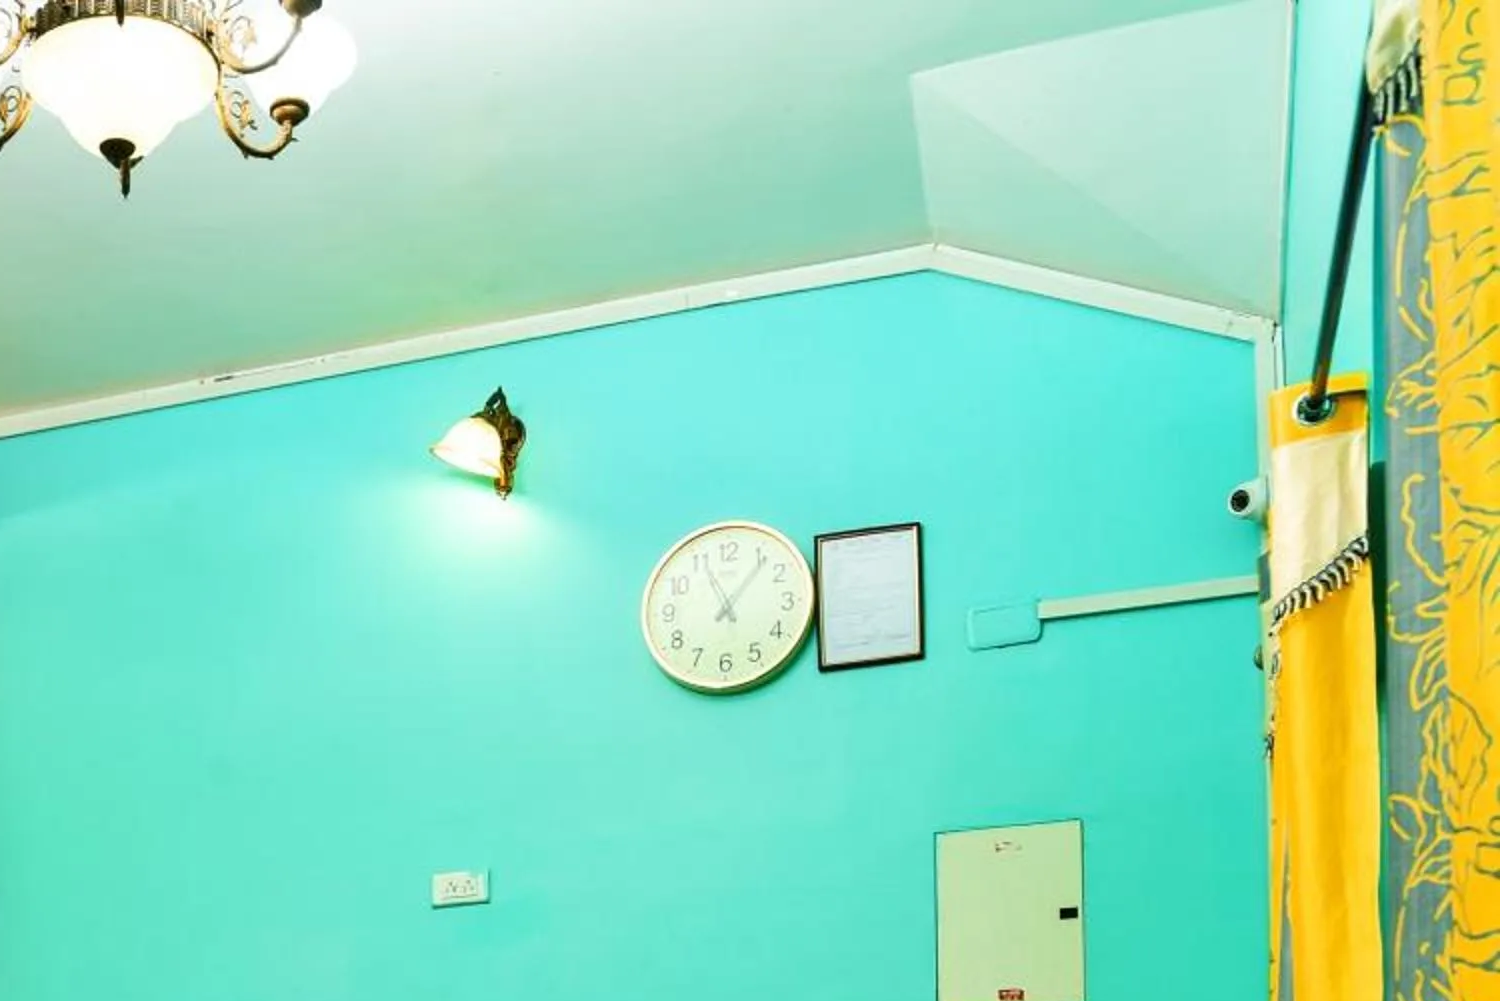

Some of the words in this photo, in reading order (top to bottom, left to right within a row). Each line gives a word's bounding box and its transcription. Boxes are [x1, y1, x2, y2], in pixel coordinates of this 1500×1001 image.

[719, 541, 739, 562] 12
[693, 552, 709, 573] 11
[772, 563, 786, 583] 2
[671, 574, 689, 596] 10
[781, 591, 795, 611] 3
[662, 603, 675, 622] 9
[769, 619, 783, 639] 4
[671, 630, 684, 650] 8
[692, 647, 704, 668] 7
[747, 642, 761, 663] 5
[719, 653, 733, 673] 6
